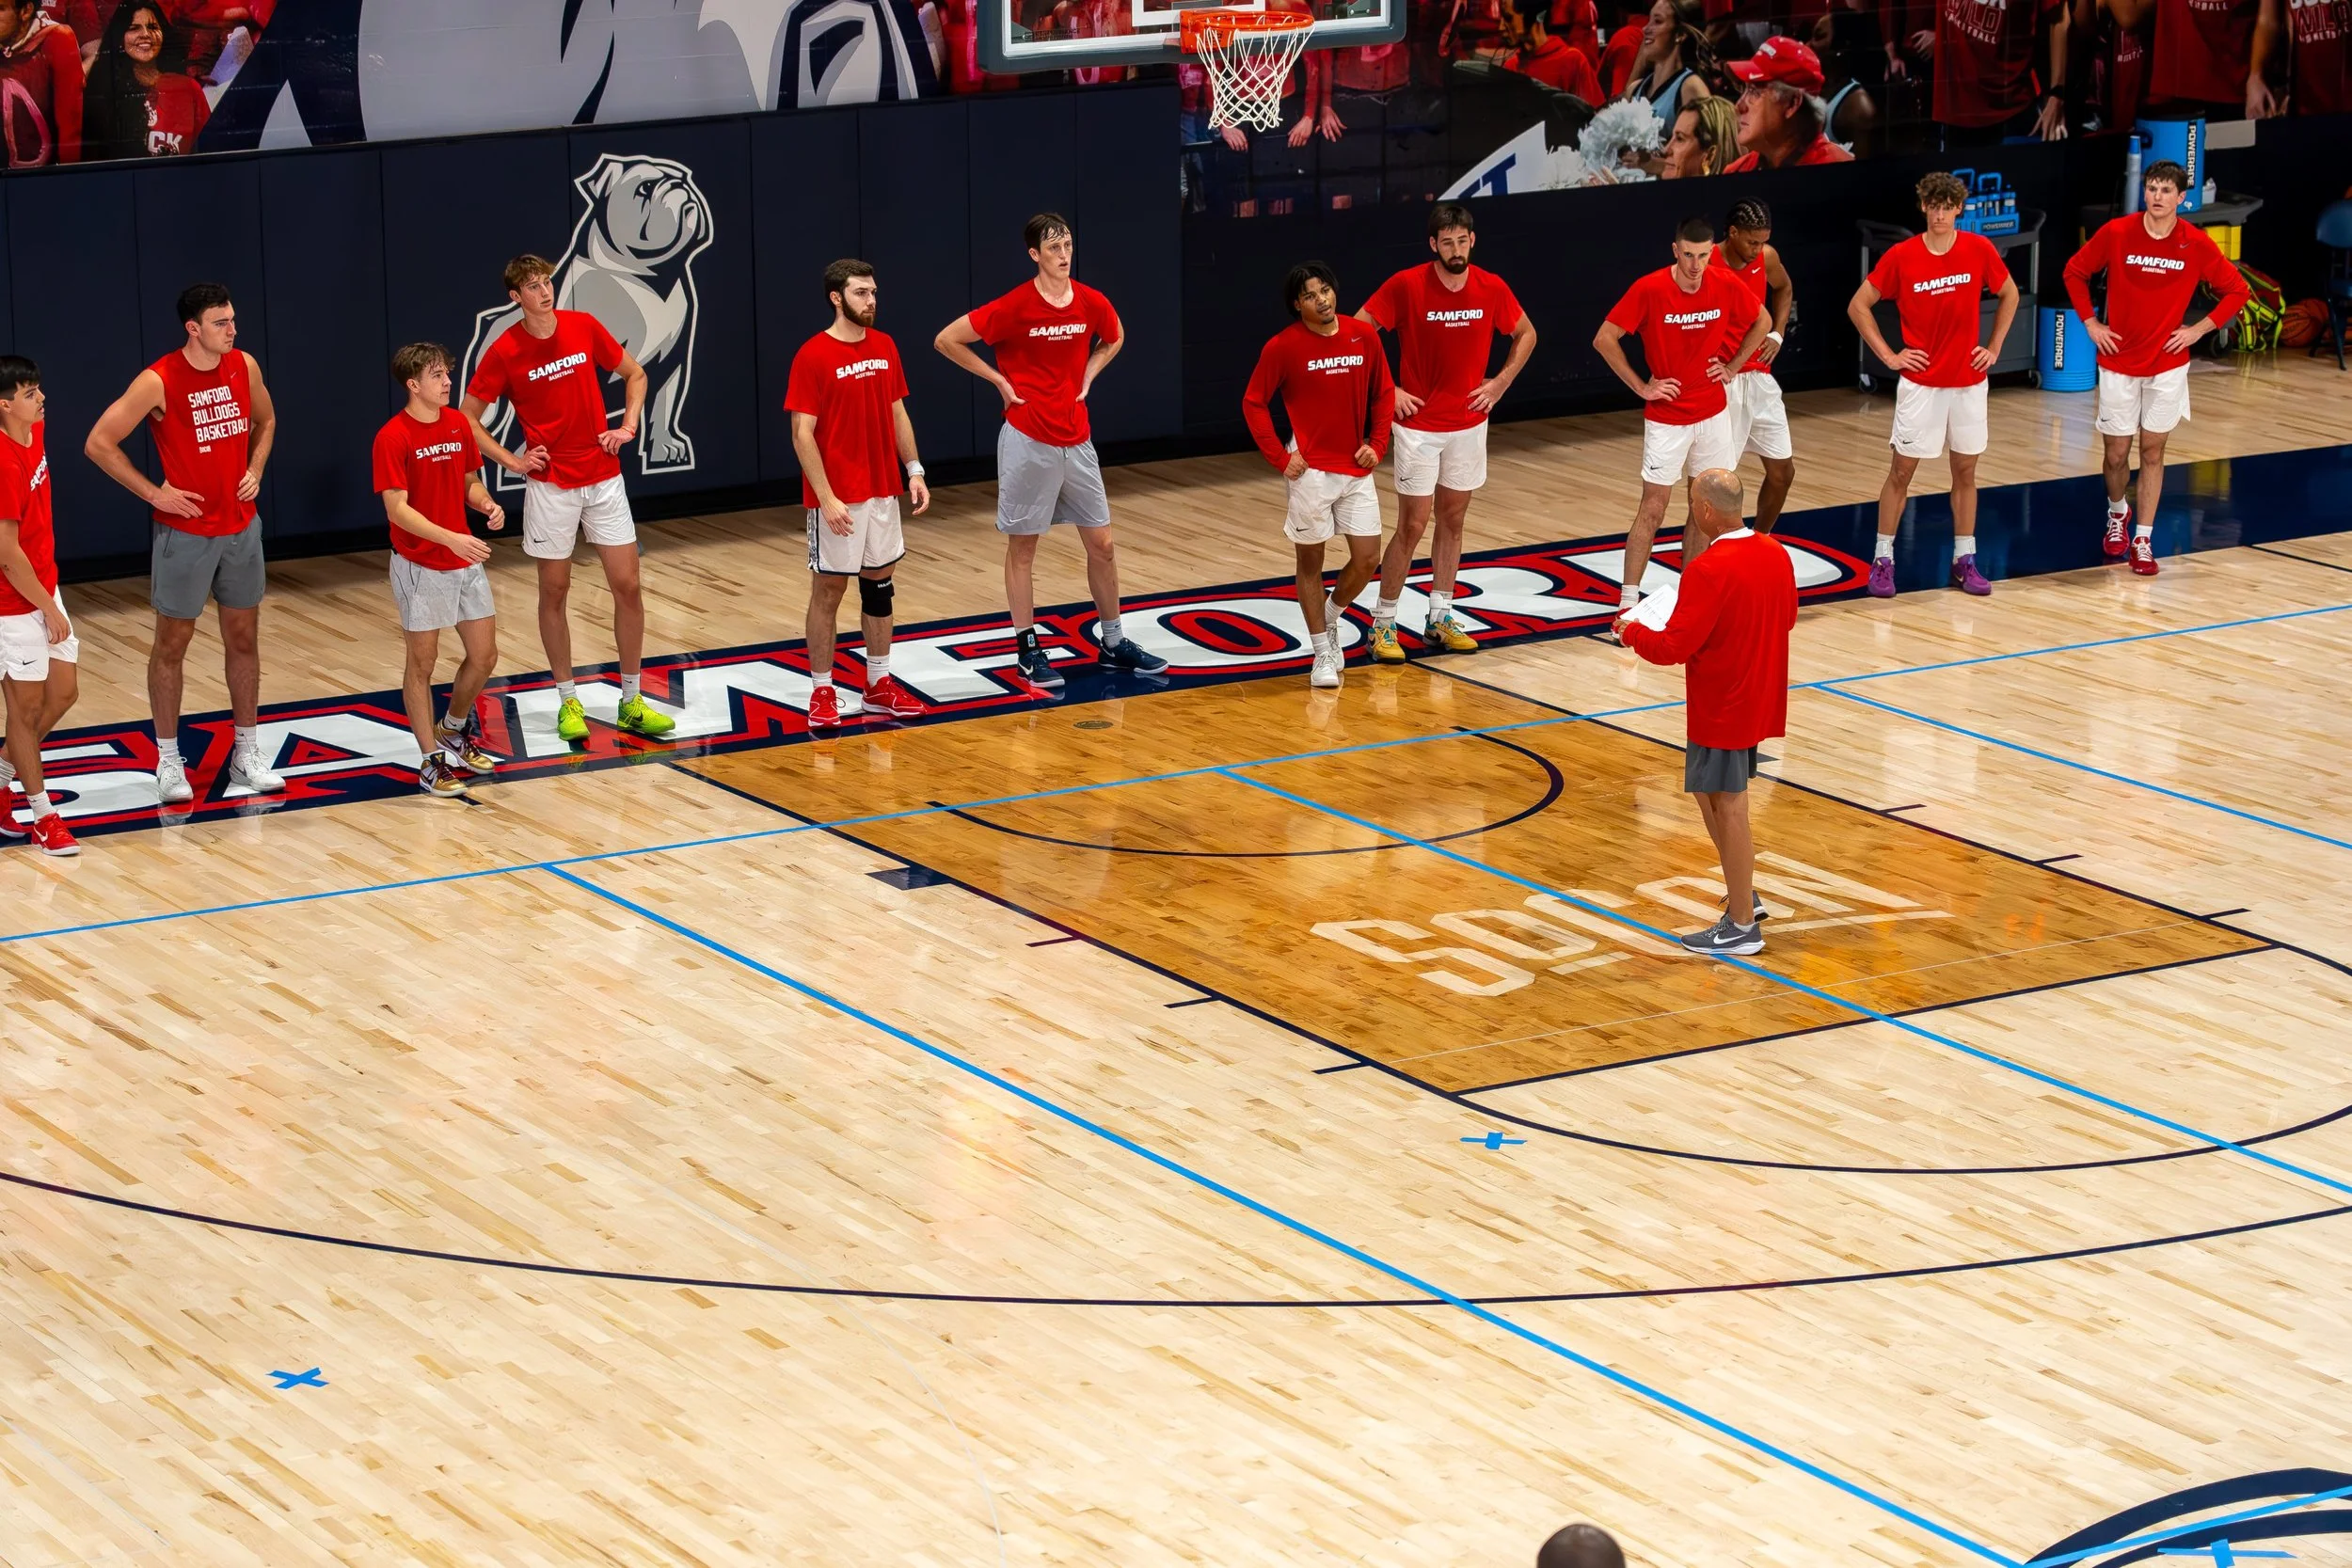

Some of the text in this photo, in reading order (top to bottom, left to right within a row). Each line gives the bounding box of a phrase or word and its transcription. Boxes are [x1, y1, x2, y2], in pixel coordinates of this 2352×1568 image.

[2187, 124, 2197, 187] POWERADE
[2126, 254, 2185, 271] SAMFORD
[2141, 266, 2166, 275] BASKETBALL
[1913, 273, 1972, 293] SAMFORD
[1931, 286, 1956, 295] BASKETBALL
[1425, 309, 1484, 322] SAMFORD
[1663, 309, 1722, 324] SAMFORD
[1028, 323, 1088, 337] SAMFORD
[2055, 314, 2065, 369] POWERADE
[528, 352, 587, 381] SAMFORD
[835, 358, 889, 379] SAMFORD
[1307, 355, 1364, 372] SAMFORD
[548, 368, 575, 382] BASKETBALL
[188, 385, 232, 408] SAMFORD
[192, 402, 241, 426] BULLDOGS
[415, 441, 462, 460] SAMFORD
